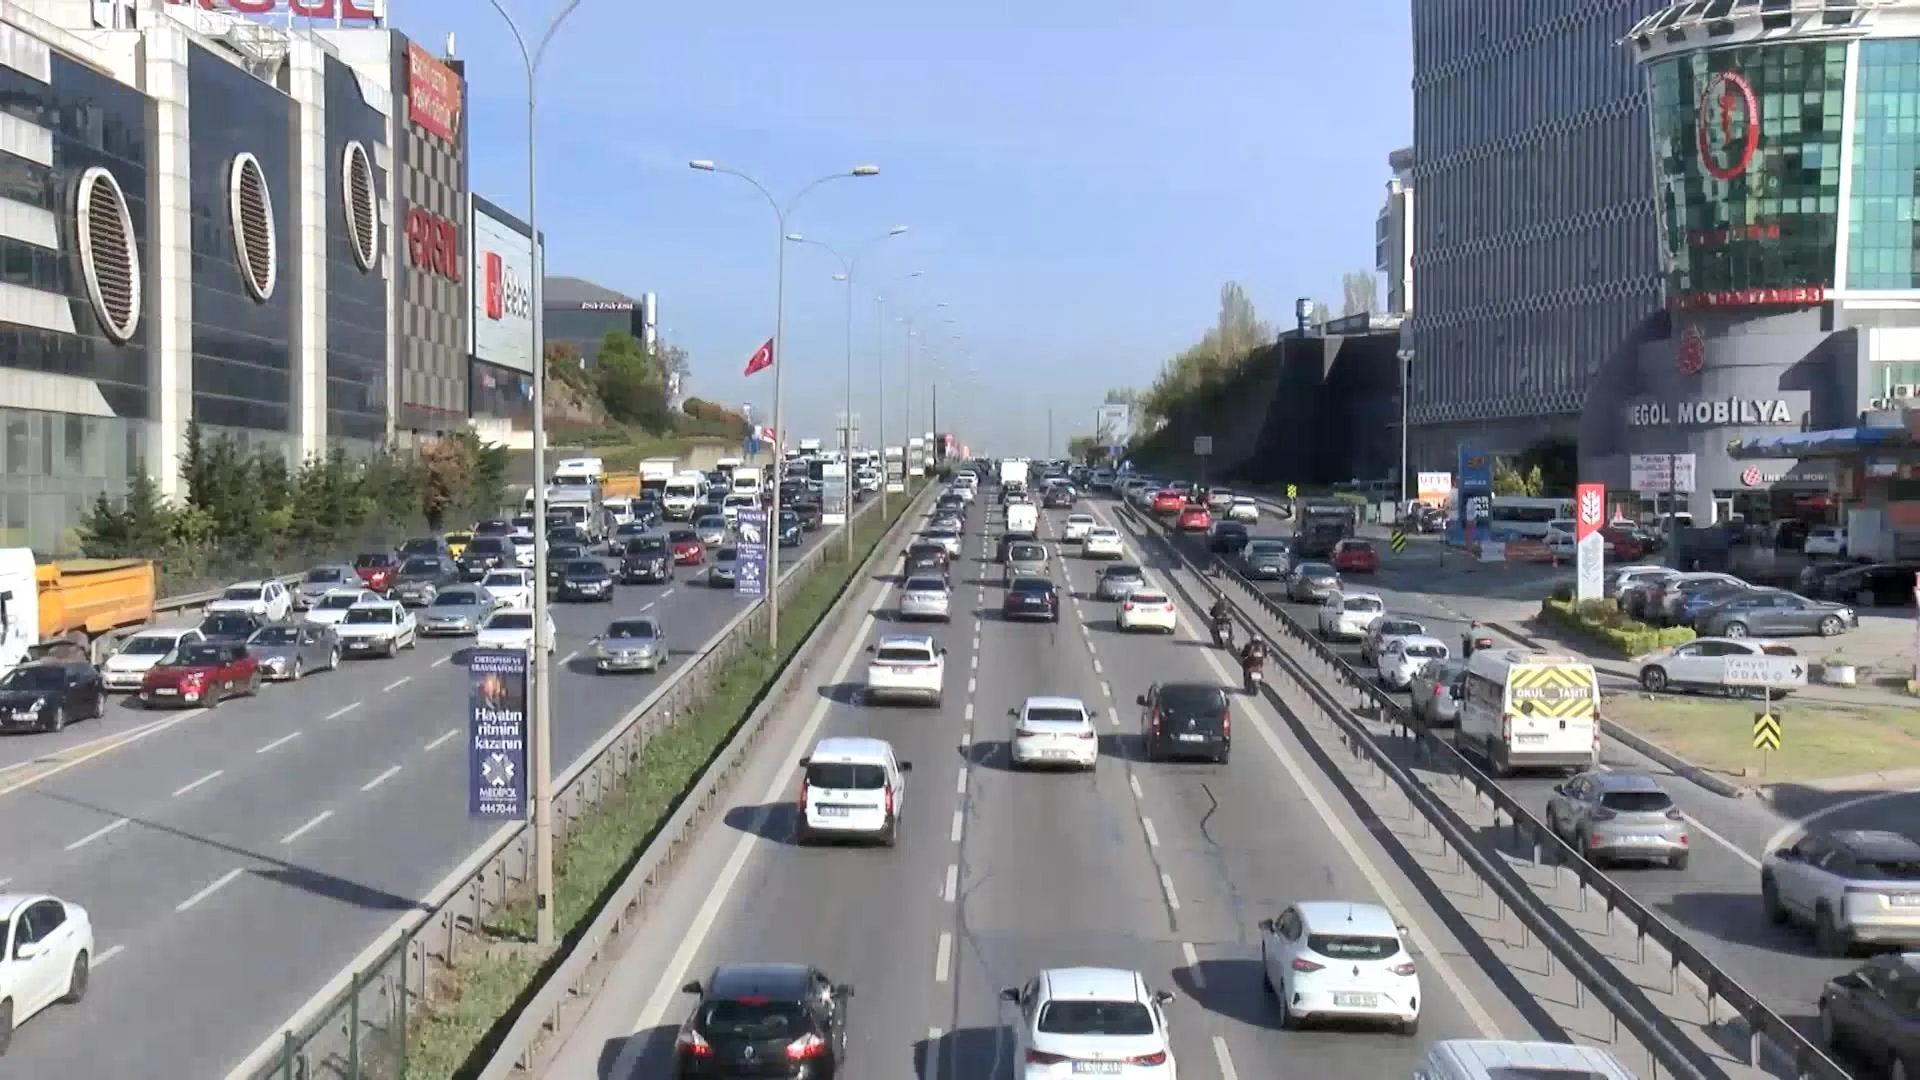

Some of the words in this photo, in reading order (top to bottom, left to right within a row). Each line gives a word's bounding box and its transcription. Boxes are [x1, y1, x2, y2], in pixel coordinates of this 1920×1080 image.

[1677, 396, 1792, 424] MOBİLYA
[1516, 687, 1545, 698] OKUL
[475, 708, 522, 724] Hayatın
[478, 722, 519, 735] ritmini
[475, 736, 522, 750] kazanın
